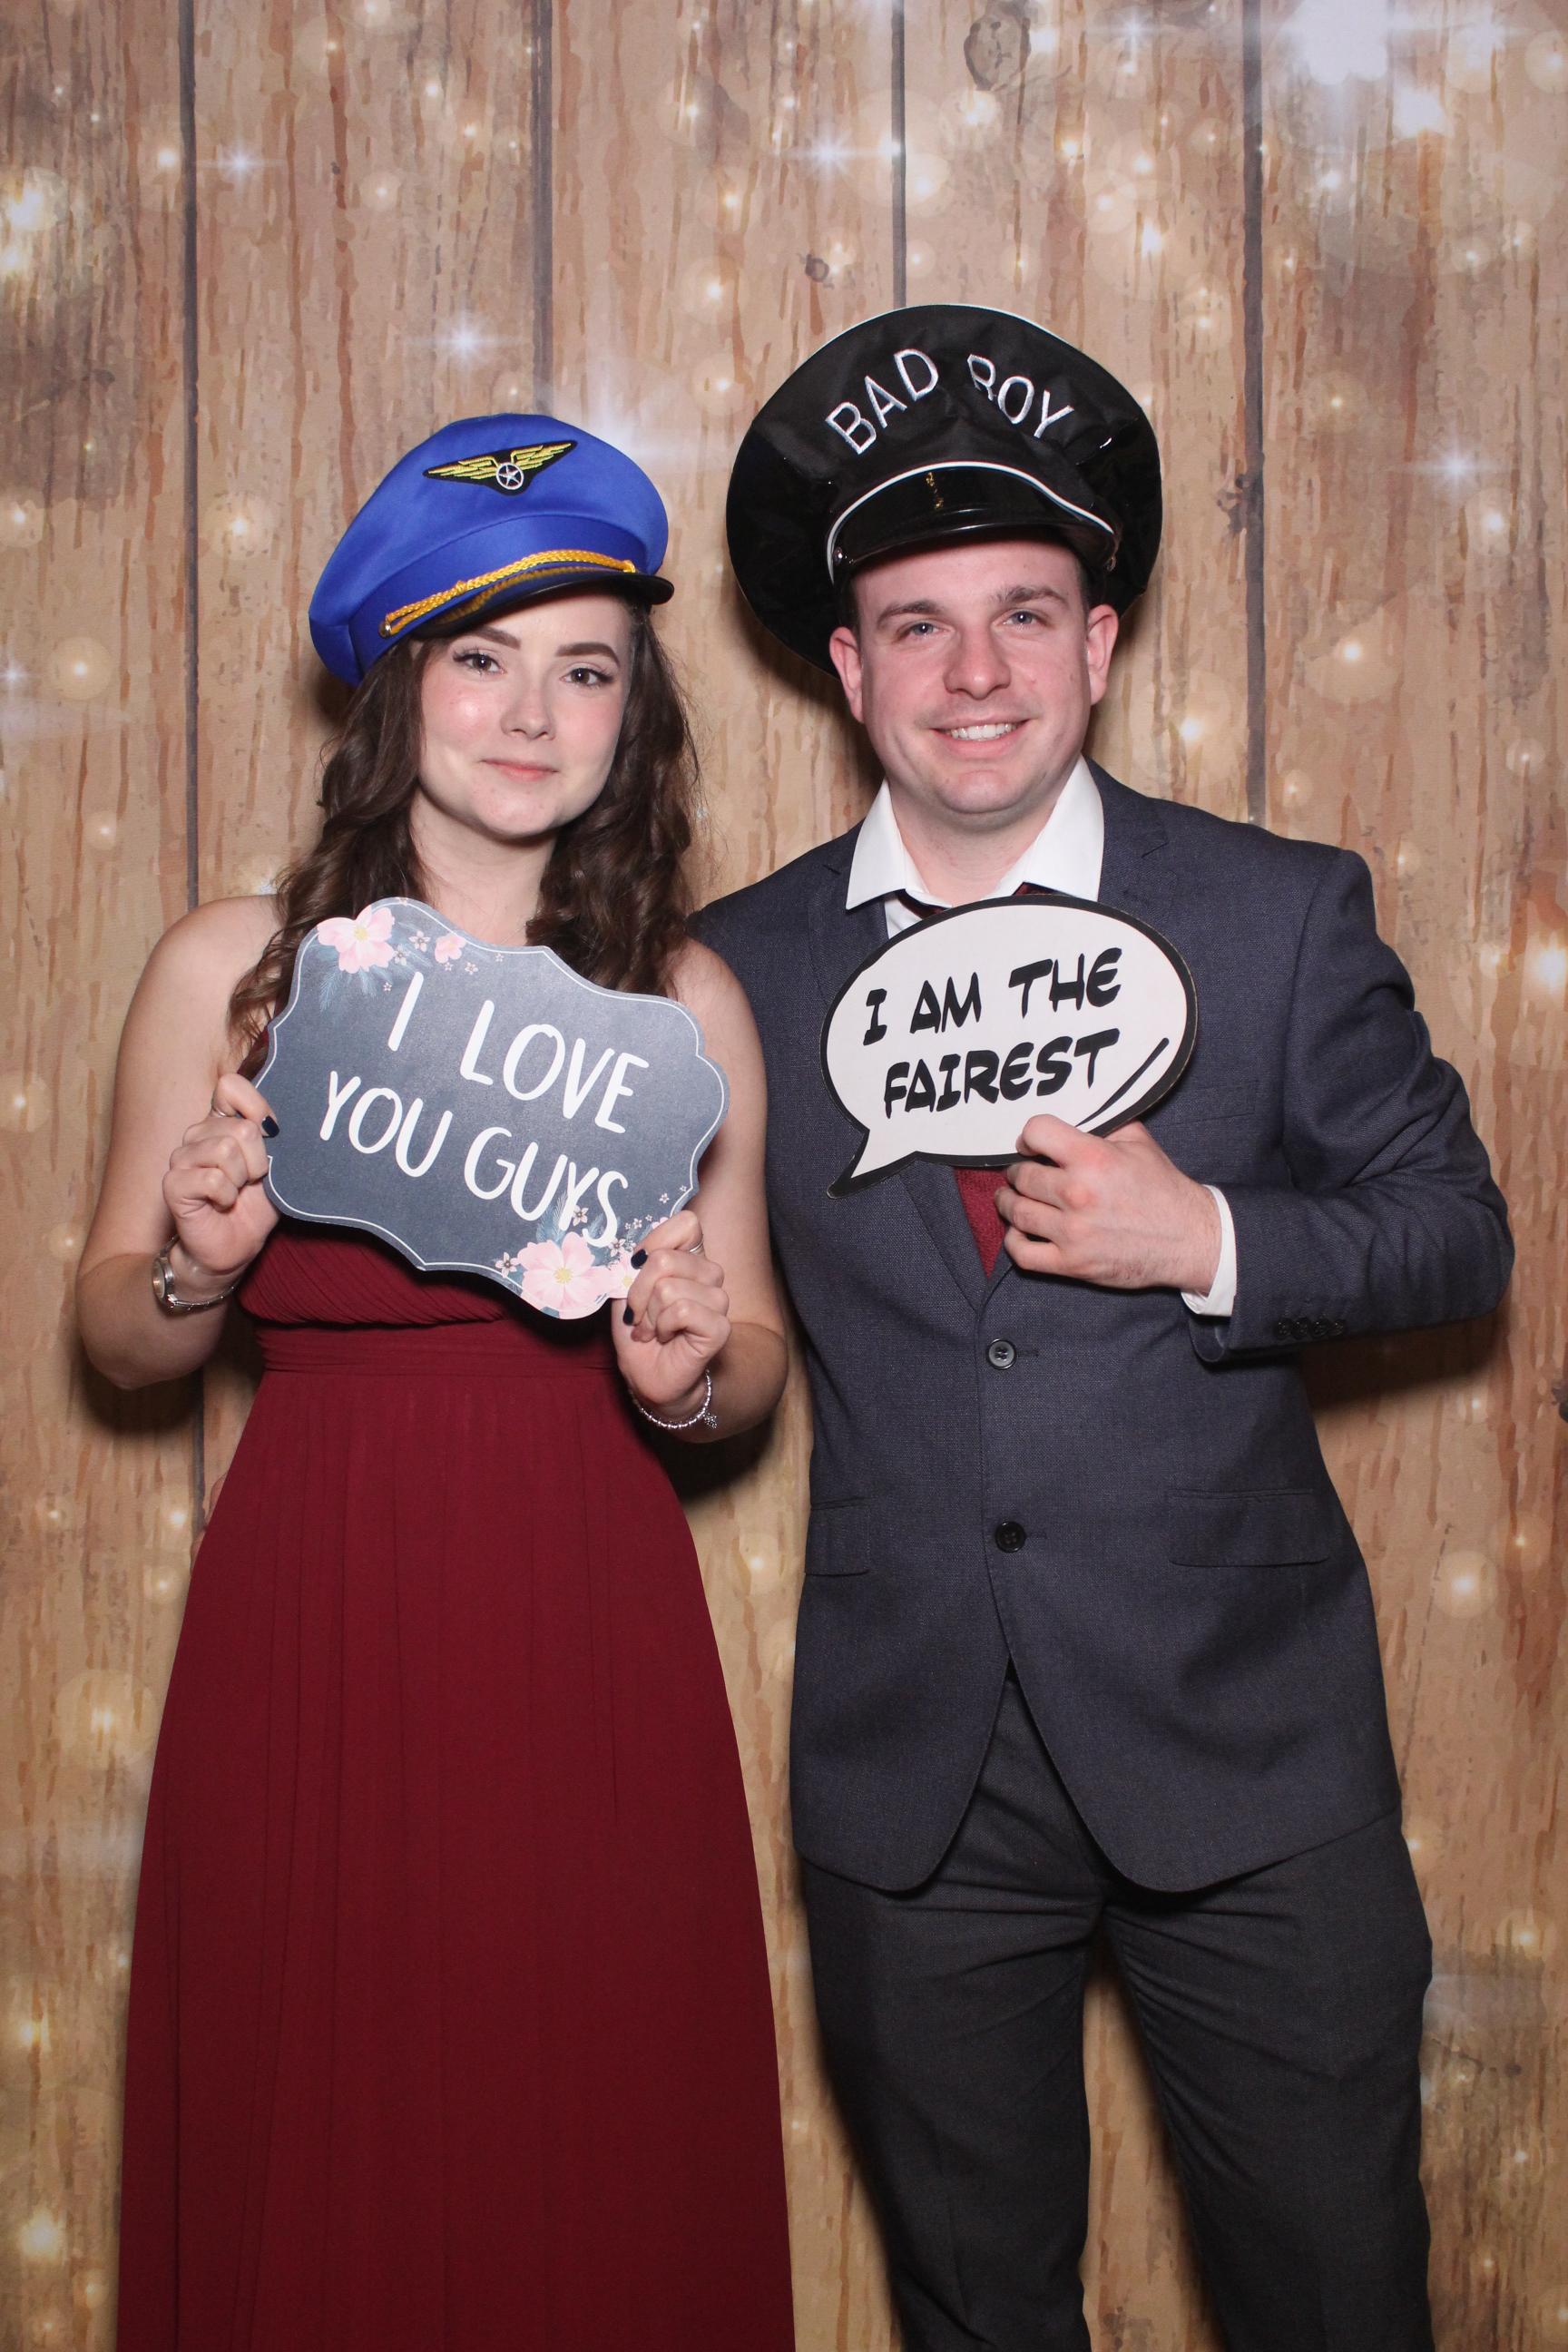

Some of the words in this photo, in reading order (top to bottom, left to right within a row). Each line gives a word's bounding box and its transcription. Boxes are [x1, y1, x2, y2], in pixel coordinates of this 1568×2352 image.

[825, 348, 939, 455] BAD
[862, 988, 887, 1046] I
[909, 972, 982, 1034] AM
[1008, 947, 1122, 1018] THE
[387, 971, 424, 1052] I
[459, 999, 650, 1134] LOVE
[883, 1027, 1121, 1119] FAIREST
[319, 1071, 454, 1178] YOU
[464, 1126, 629, 1249] GUYS
